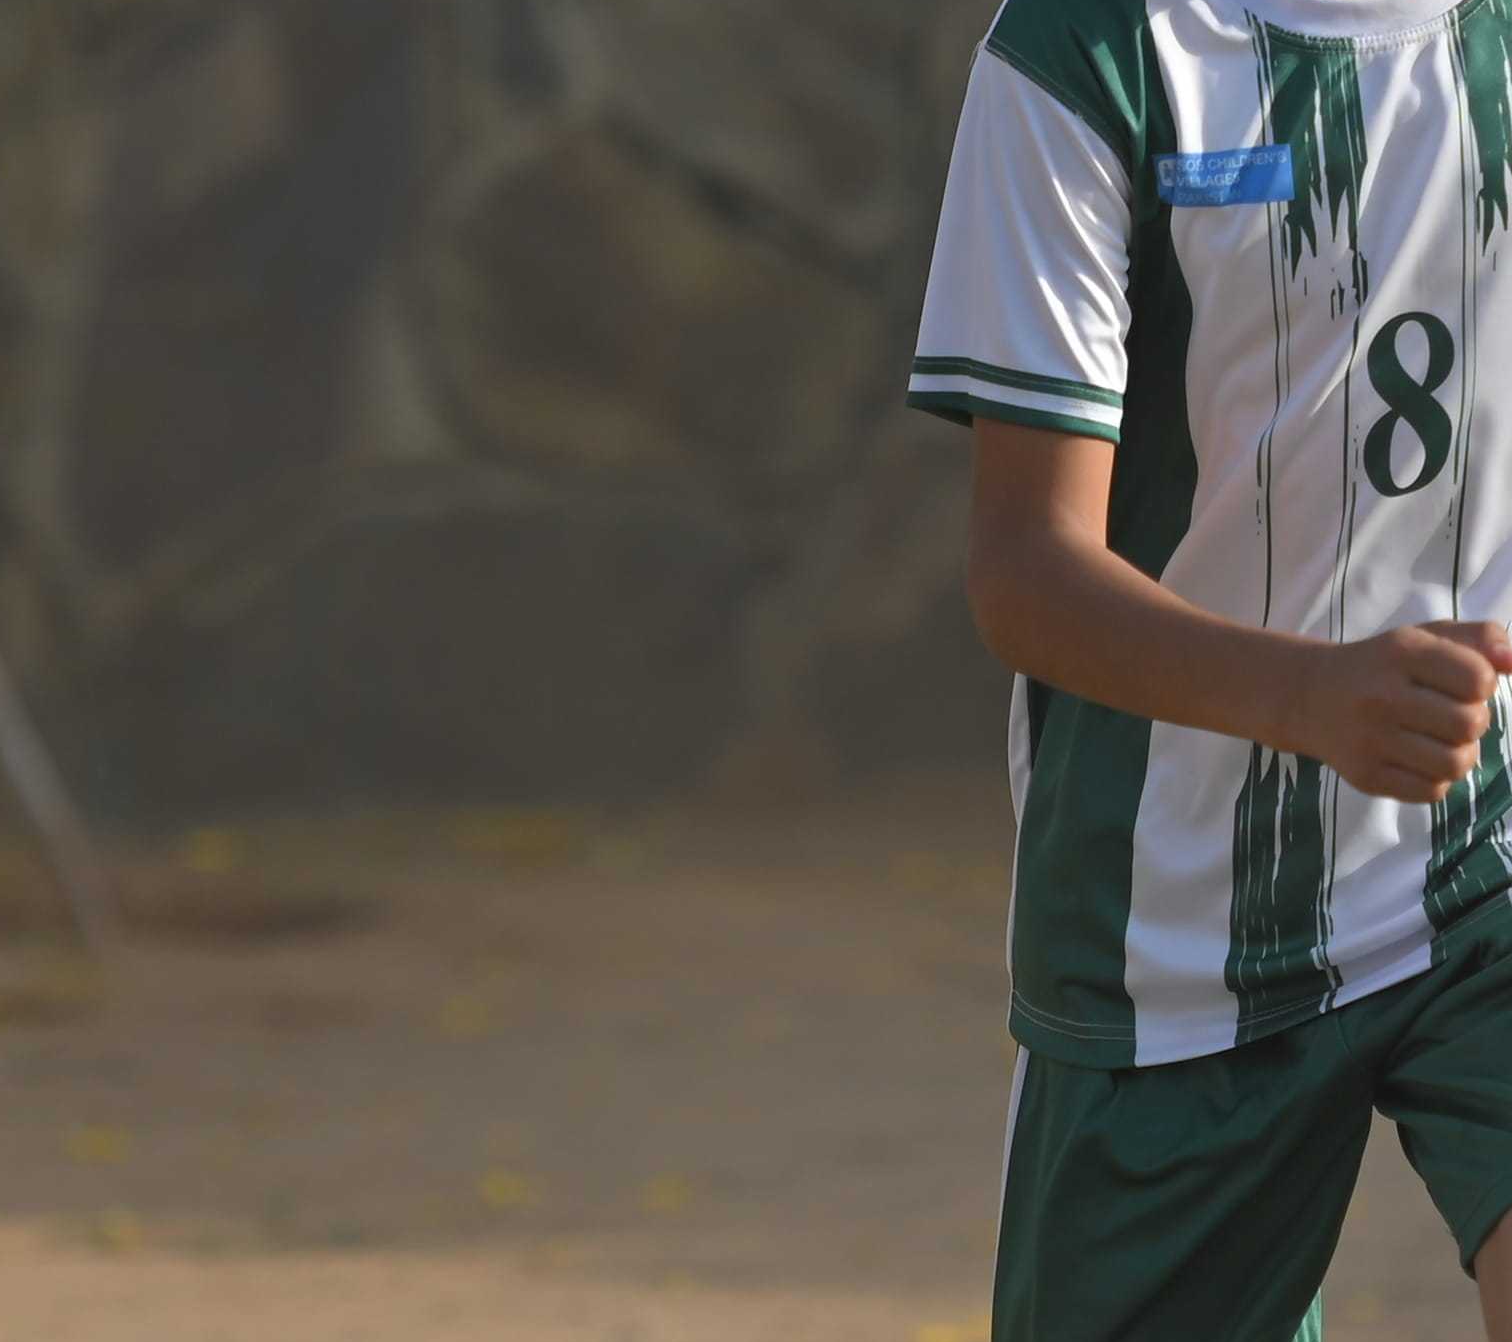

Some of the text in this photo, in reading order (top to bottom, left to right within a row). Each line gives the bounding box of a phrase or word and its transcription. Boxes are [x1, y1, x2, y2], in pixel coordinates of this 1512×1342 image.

[1176, 157, 1205, 173] SOS
[1177, 170, 1240, 188] VILLAGES
[1363, 311, 1455, 497] 8
